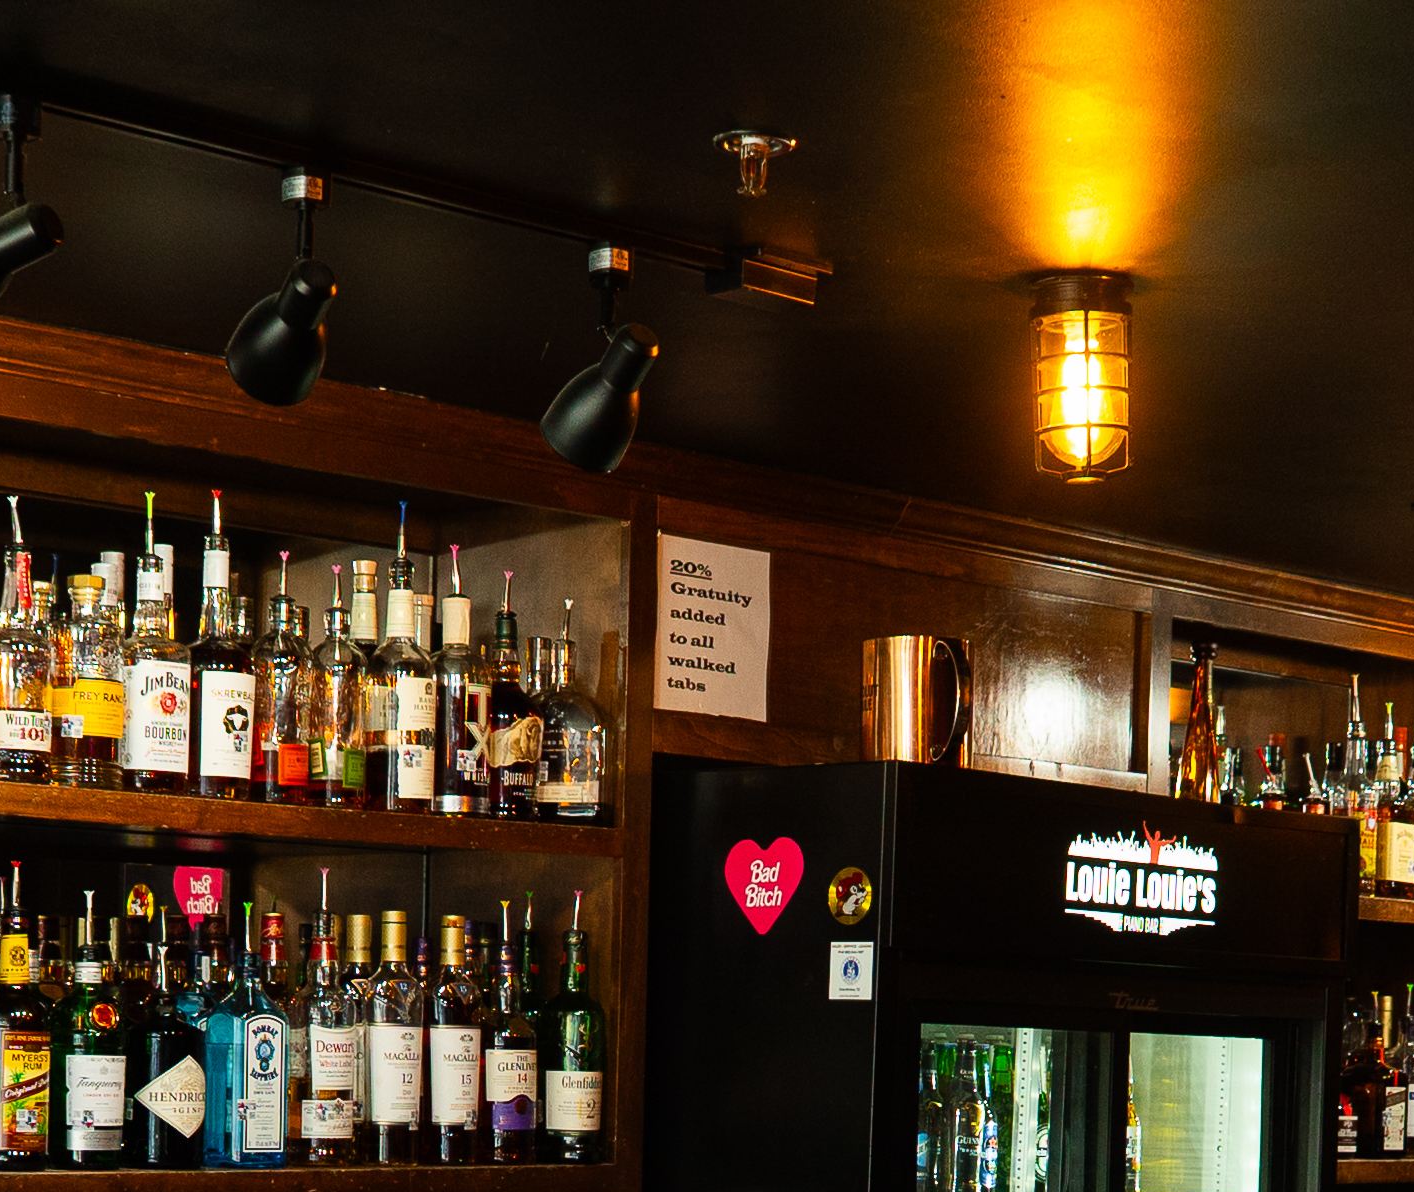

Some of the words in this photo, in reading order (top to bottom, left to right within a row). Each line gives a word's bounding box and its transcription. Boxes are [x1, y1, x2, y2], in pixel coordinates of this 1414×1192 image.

[669, 558, 712, 577] 20%
[670, 581, 752, 608] Gratuity
[670, 607, 726, 626] added
[669, 631, 688, 645] to
[690, 634, 714, 649] all
[667, 654, 736, 675] walked
[141, 675, 164, 696] JIM
[667, 676, 706, 693] tabs
[72, 691, 100, 701] FREY
[5, 713, 31, 727] WILD
[19, 727, 45, 742] 101
[750, 859, 781, 883] Bad
[745, 883, 783, 908] Bitch
[1065, 861, 1131, 906] Louie
[1135, 868, 1217, 914] Louie's
[251, 1024, 279, 1038] BOMBAY
[23, 1062, 43, 1070] RUM
[401, 1073, 413, 1084] 12
[460, 1074, 472, 1085] 15
[516, 1073, 528, 1084] 14
